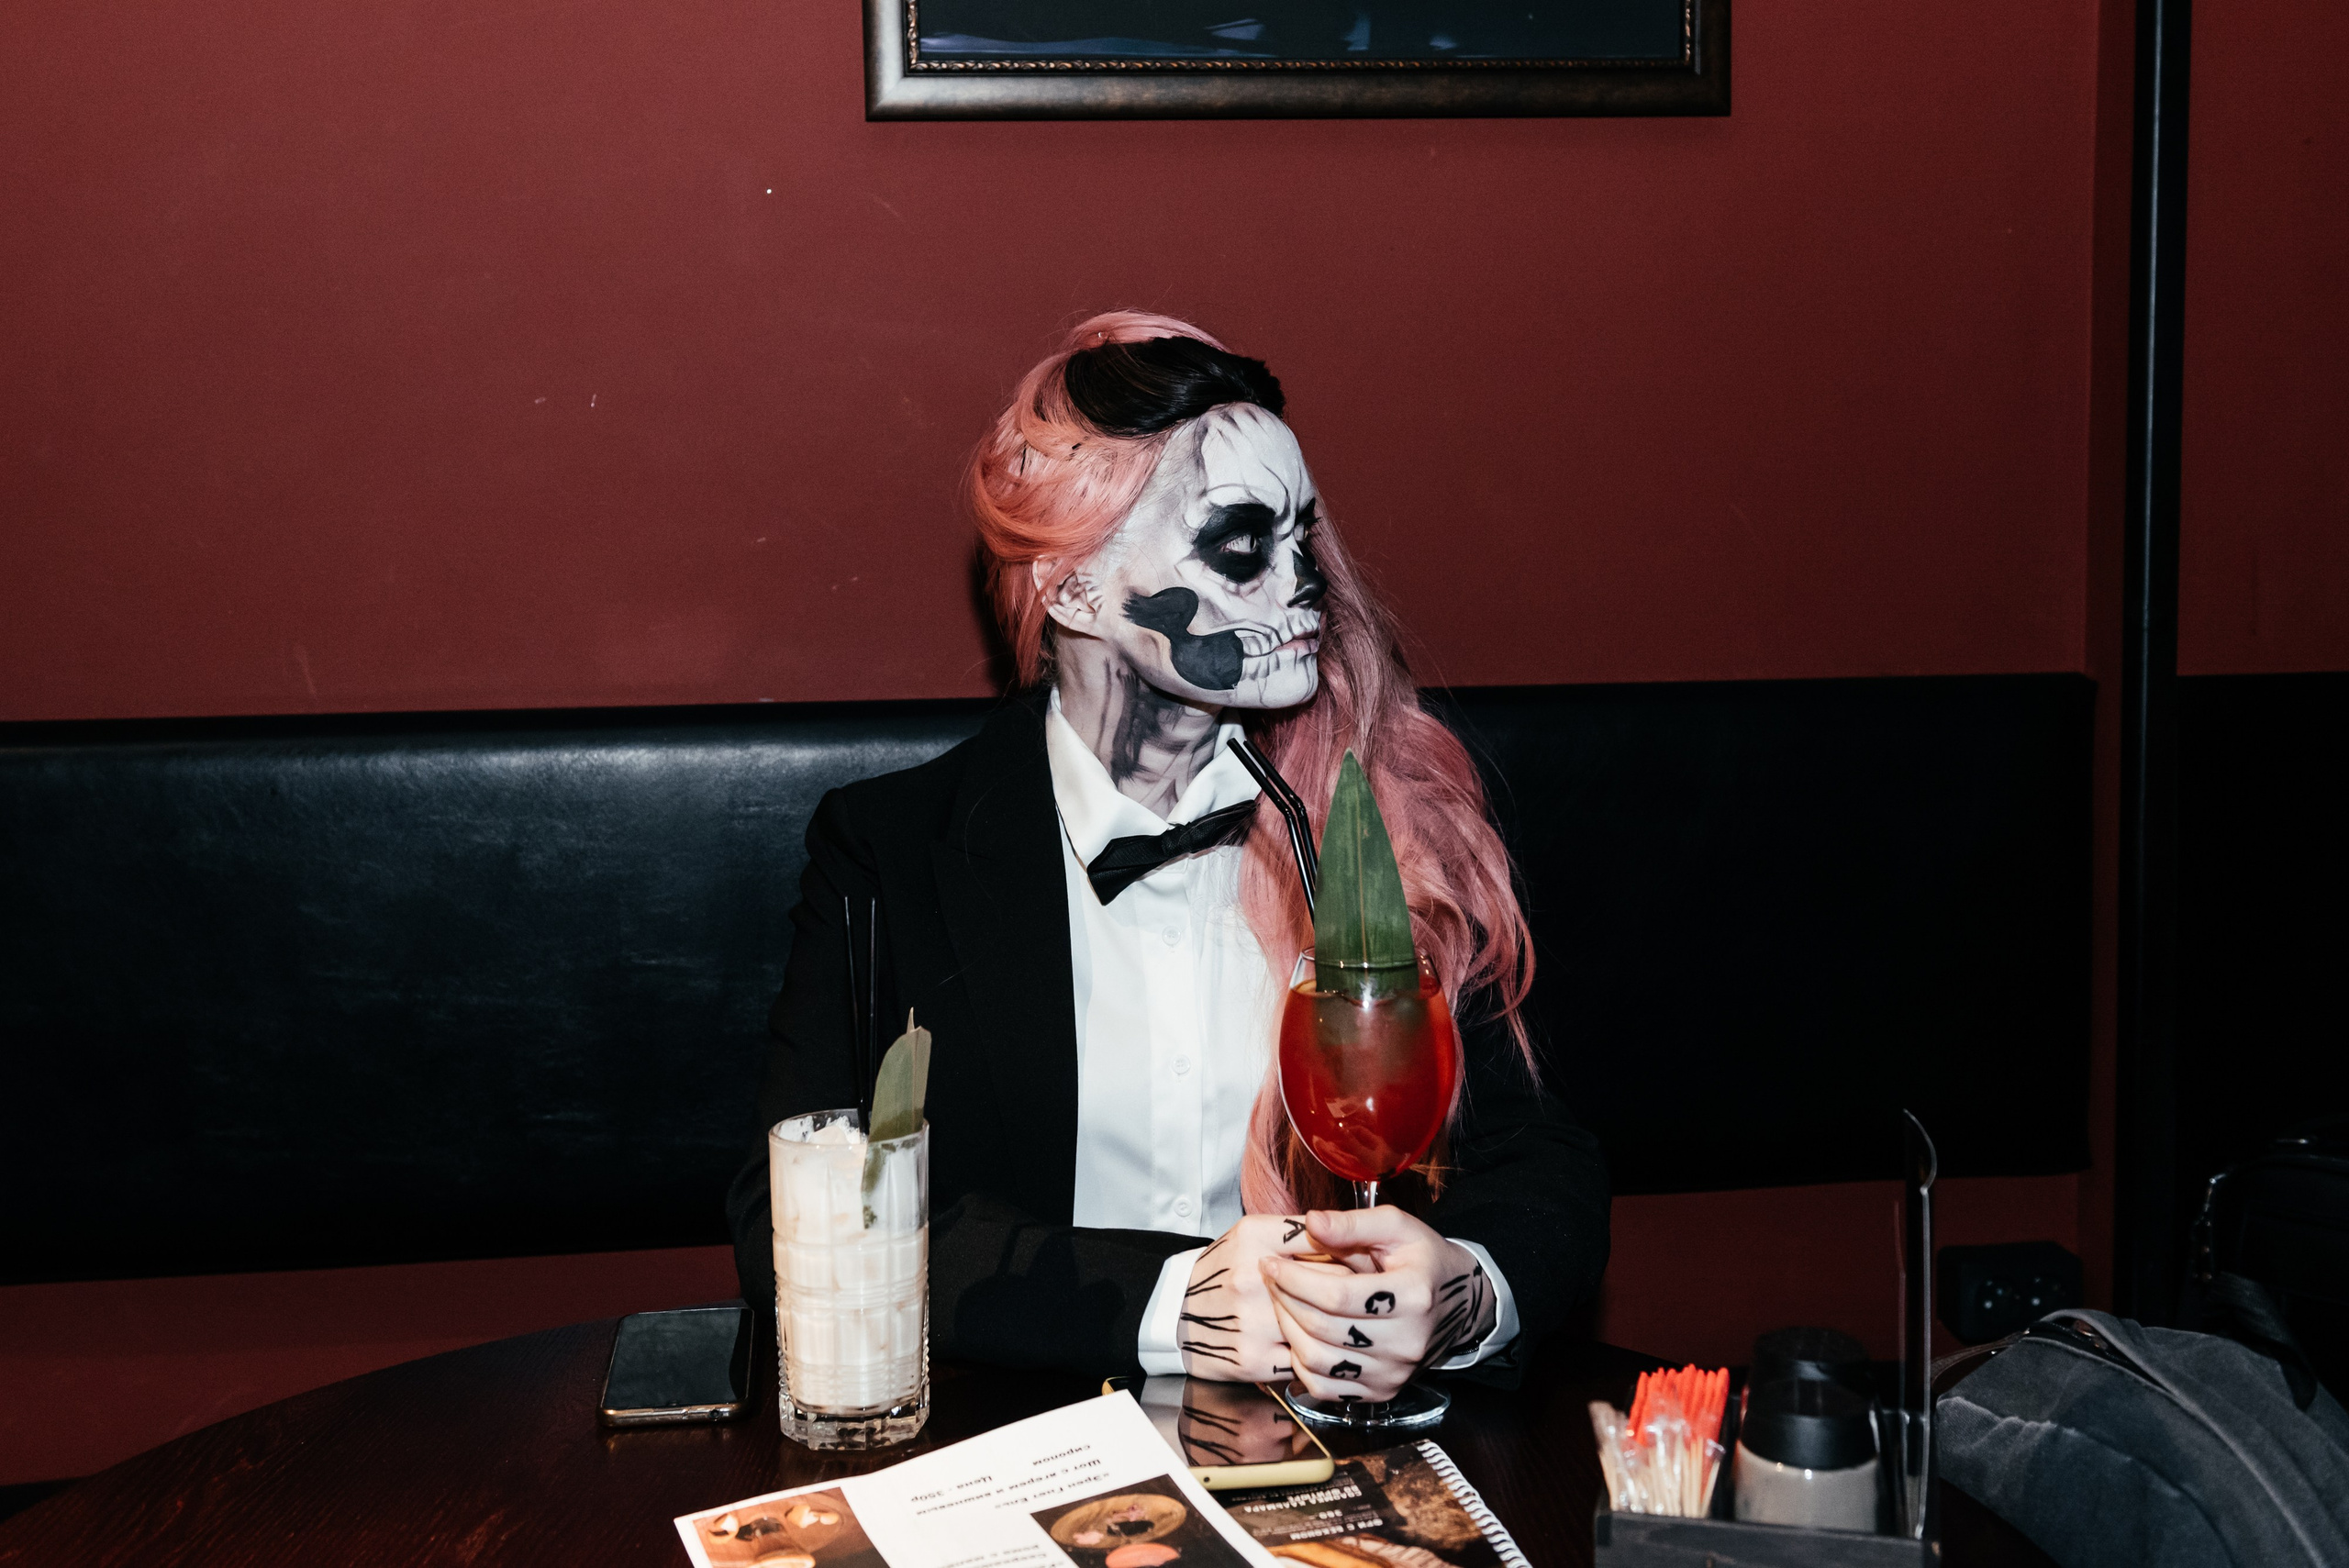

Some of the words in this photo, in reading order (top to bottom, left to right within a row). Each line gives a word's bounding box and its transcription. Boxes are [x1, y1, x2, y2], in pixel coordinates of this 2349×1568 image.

[1032, 1444, 1091, 1466] сиропом
[1074, 1459, 1101, 1471] Шот
[956, 1475, 993, 1490] Цена
[1008, 1473, 1057, 1490] ягерем
[910, 1491, 945, 1503] 350р
[916, 1492, 992, 1516] вишневым
[1243, 1500, 1306, 1514] КАЛЬМАРА
[1357, 1518, 1384, 1530] ФРИ
[1289, 1524, 1344, 1540] БЕКОНОМ
